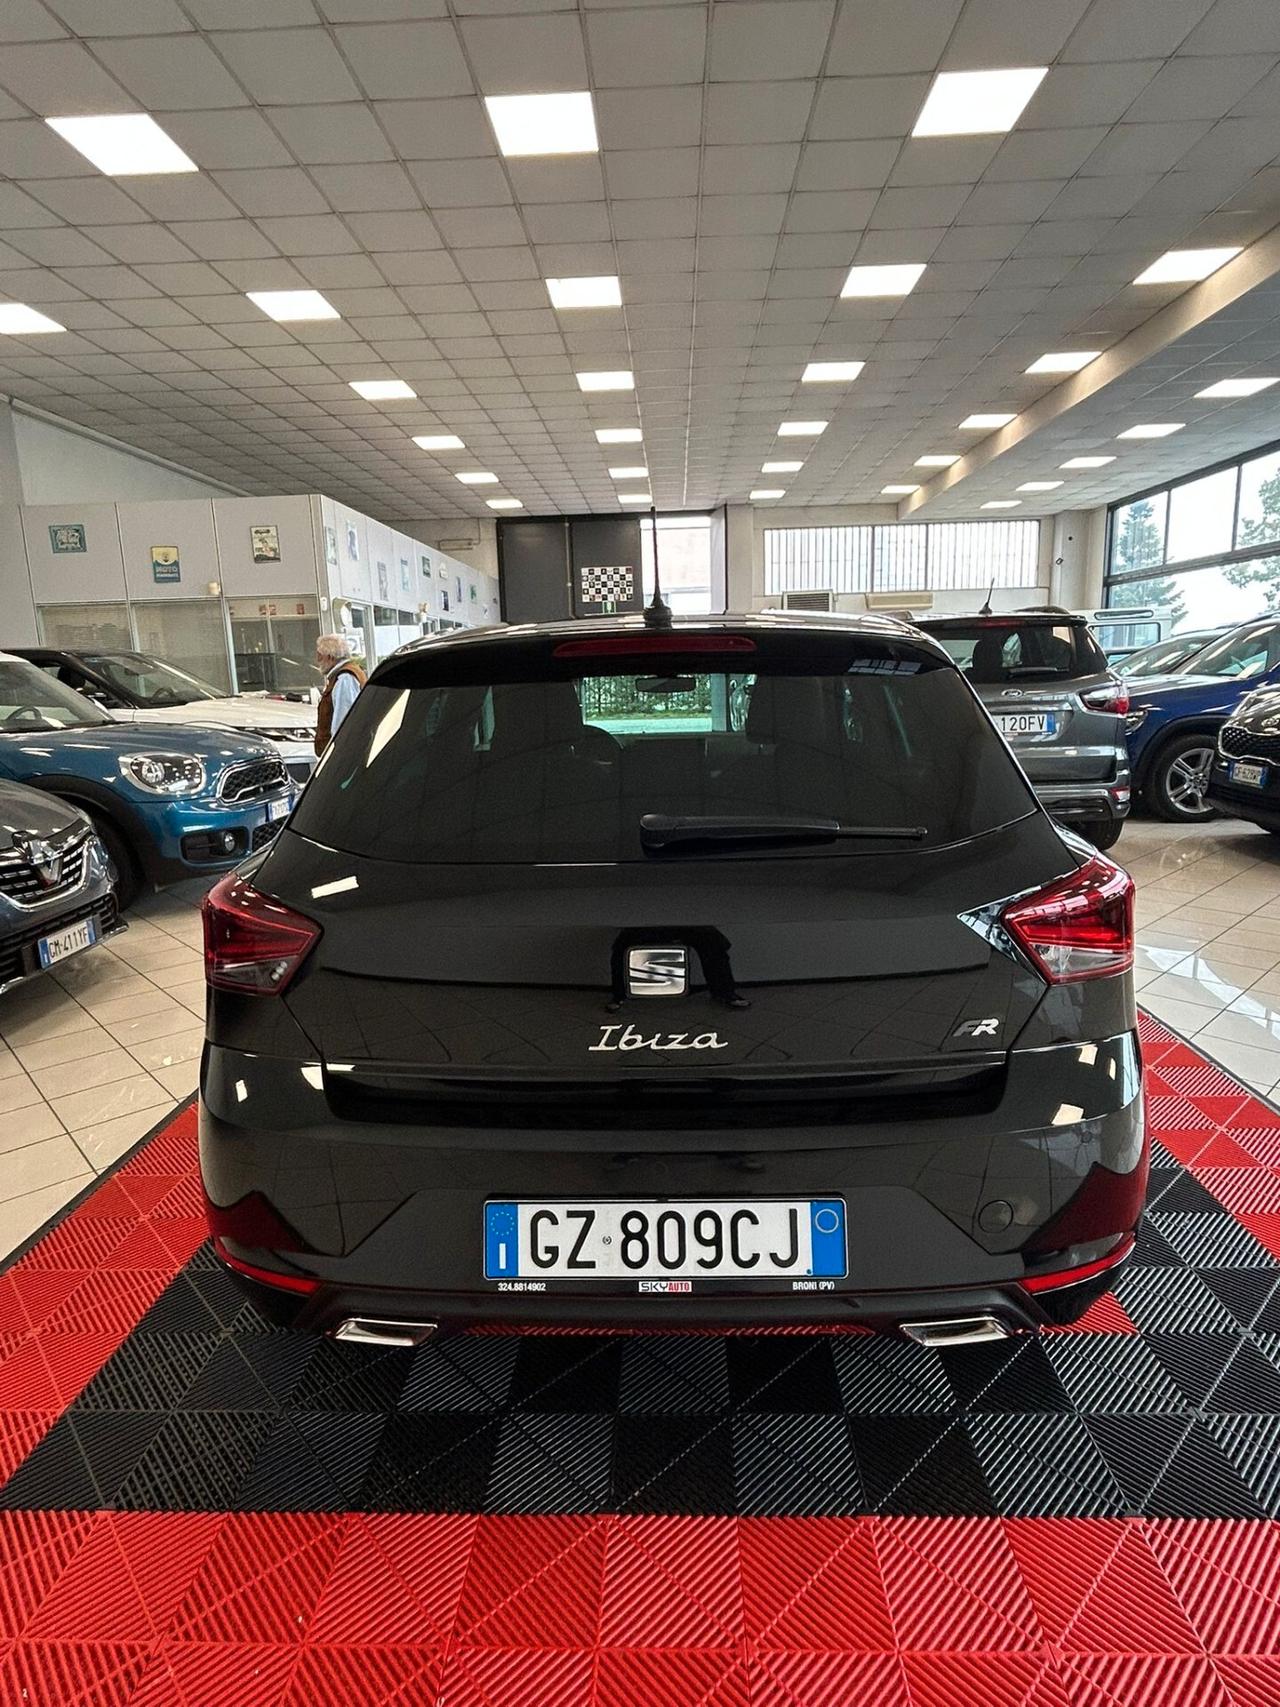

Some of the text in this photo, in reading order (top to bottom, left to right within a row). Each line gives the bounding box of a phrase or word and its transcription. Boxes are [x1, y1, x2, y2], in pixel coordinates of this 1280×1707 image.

[1001, 715, 1046, 731] 120FV
[952, 1018, 999, 1037] FR
[588, 1024, 729, 1051] Ibiza
[497, 1282, 547, 1292] 324.8814902
[792, 1281, 835, 1290] BRONI (PV)
